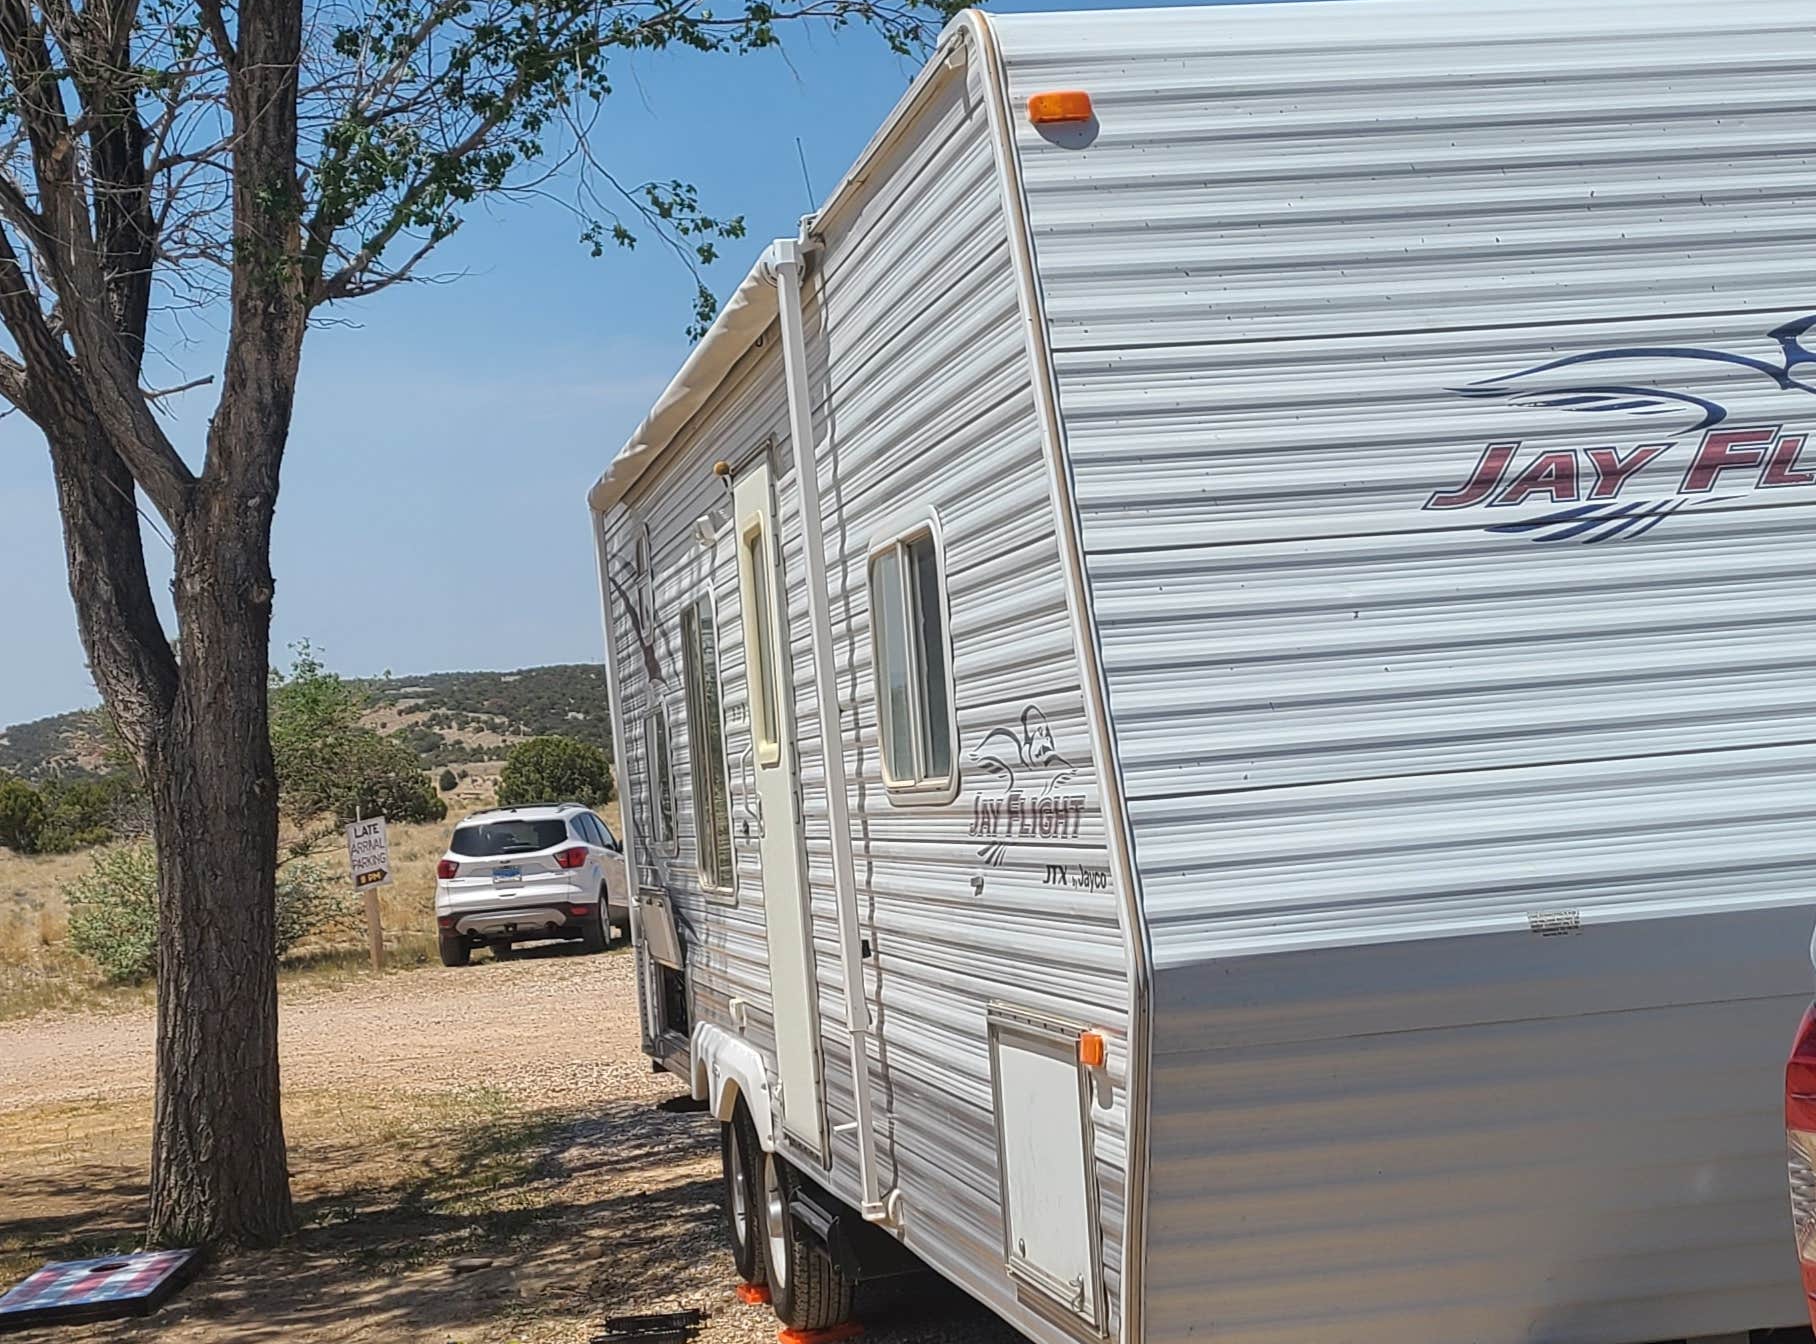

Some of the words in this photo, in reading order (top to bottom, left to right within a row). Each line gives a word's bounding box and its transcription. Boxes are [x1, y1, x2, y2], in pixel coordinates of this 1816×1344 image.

[1422, 441, 1678, 510] JAY
[968, 792, 1004, 837] JAY
[1005, 790, 1086, 839] FLIGHT
[354, 823, 379, 838] LATE
[352, 853, 386, 871] PARKING
[1043, 864, 1067, 885] JTX
[1078, 864, 1107, 893] Jayco
